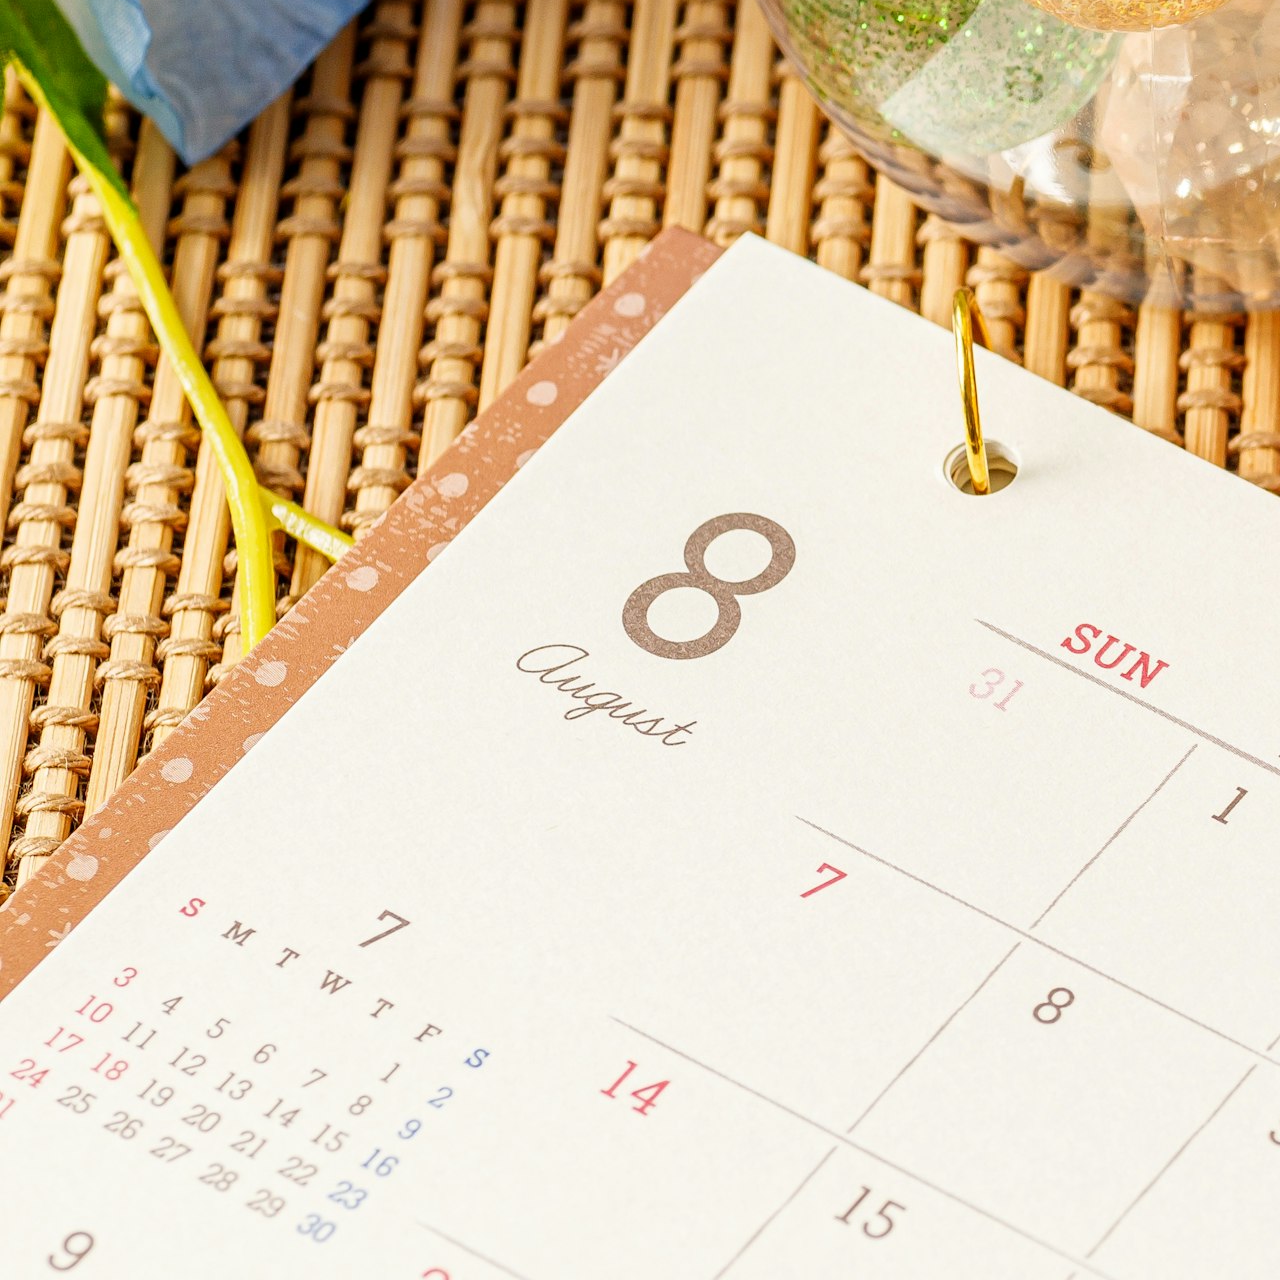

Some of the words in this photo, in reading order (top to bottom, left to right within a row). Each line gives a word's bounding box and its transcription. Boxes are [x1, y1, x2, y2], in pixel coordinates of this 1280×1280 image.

[622, 512, 796, 660] 8
[1060, 623, 1170, 689] SUN
[516, 644, 697, 746] August
[969, 668, 1024, 711] 31
[1211, 787, 1248, 825] 1
[179, 898, 206, 917] S
[221, 920, 257, 947] M
[275, 947, 301, 968] T
[320, 970, 352, 995] W
[370, 998, 394, 1018] T
[414, 1024, 443, 1042] F
[464, 1049, 490, 1068] S
[358, 909, 411, 948] 7
[800, 862, 848, 898] 7
[1032, 987, 1075, 1024] 8
[0, 1091, 16, 1119] 1
[44, 1027, 84, 1052] 17
[91, 1052, 128, 1080] 18
[137, 1079, 174, 1107] 19
[181, 1104, 221, 1132] 20
[230, 1131, 267, 1159] 21
[277, 1157, 318, 1186] 22
[328, 1181, 367, 1209] 23
[75, 995, 114, 1023] 10
[122, 1022, 157, 1050] 11
[168, 1047, 207, 1076] 12
[215, 1072, 253, 1100] 13
[264, 1098, 301, 1127] 14
[312, 1124, 349, 1152] 15
[362, 1149, 399, 1176] 16
[113, 967, 138, 987] 3
[162, 996, 183, 1015] 4
[206, 1018, 231, 1038] 5
[253, 1044, 277, 1064] 6
[302, 1068, 327, 1087] 7
[349, 1095, 373, 1115] 8
[398, 1120, 421, 1139] 9
[380, 1063, 400, 1083] 1
[428, 1087, 453, 1108] 2
[10, 1059, 50, 1088] 24
[56, 1086, 96, 1114] 25
[104, 1111, 143, 1139] 26
[149, 1136, 192, 1162] 27
[198, 1163, 238, 1192] 28
[246, 1189, 286, 1217] 29
[298, 1215, 336, 1241] 30
[600, 1060, 671, 1116] 14
[834, 1186, 906, 1239] 15
[47, 1231, 96, 1272] 9
